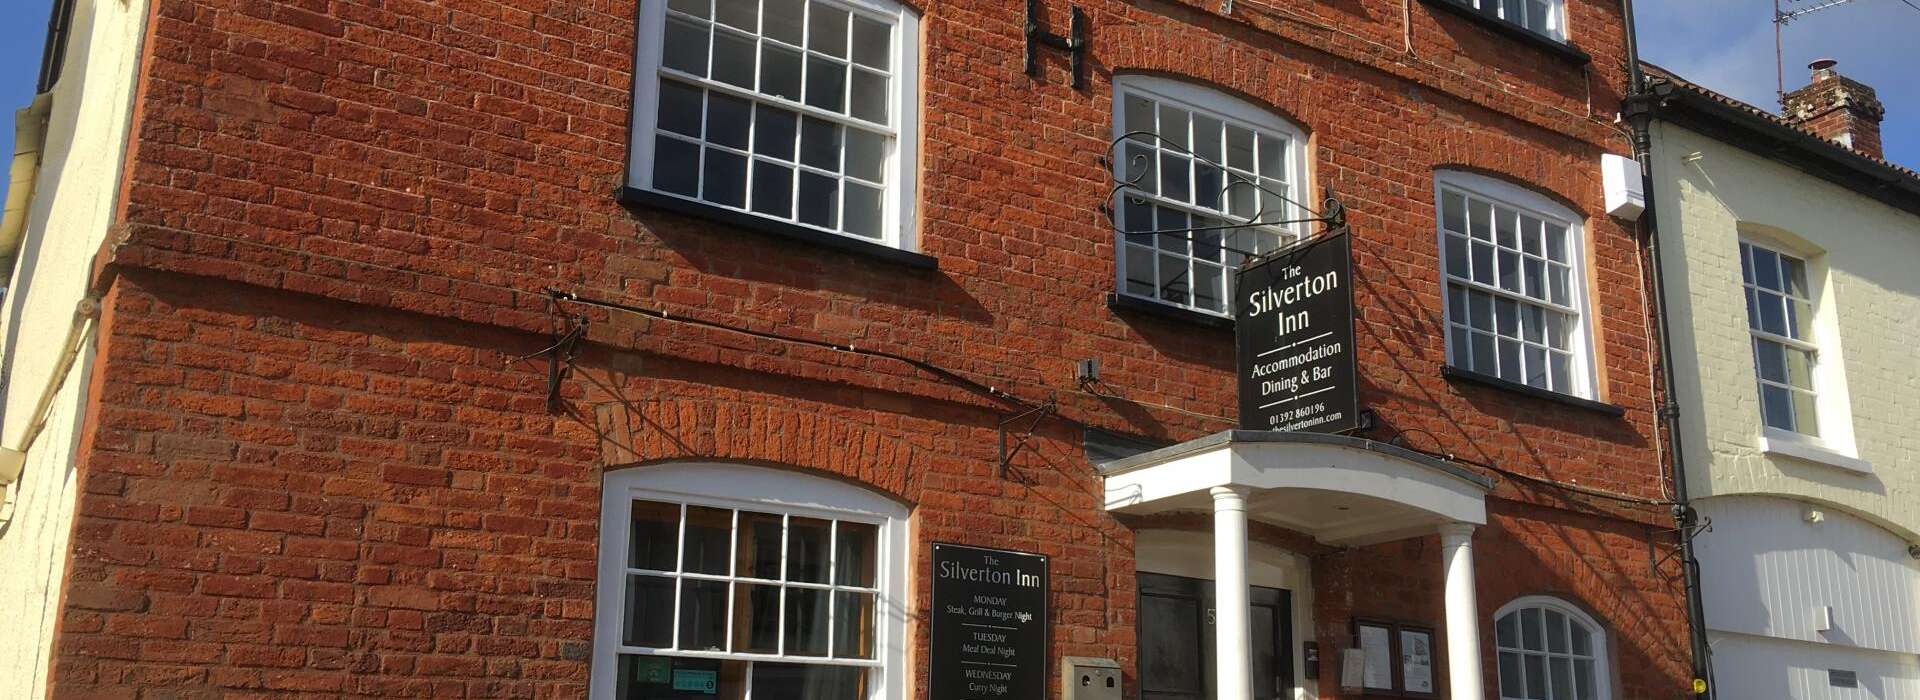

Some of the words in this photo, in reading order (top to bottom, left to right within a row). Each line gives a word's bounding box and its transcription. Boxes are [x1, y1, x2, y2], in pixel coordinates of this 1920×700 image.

[1281, 264, 1301, 281] The
[1249, 270, 1338, 317] Silverton
[1278, 310, 1309, 336] Inn
[1251, 341, 1341, 379] Accommodation
[1262, 373, 1298, 396] Dining
[1300, 369, 1310, 385] &
[1313, 365, 1332, 382] Bar
[1269, 410, 1294, 425] 01392
[1295, 402, 1325, 419] 860196
[984, 555, 1000, 566] The
[940, 560, 1011, 585] Silverton
[1016, 569, 1040, 588] Inn
[973, 595, 1007, 607] MONDAY
[969, 606, 983, 617] Grill
[984, 608, 990, 617] &
[992, 609, 1013, 621] Burger
[1014, 610, 1032, 623] Night
[973, 632, 1007, 643] TUESDAY
[962, 643, 979, 653] Meal
[980, 644, 996, 655] Deal
[997, 645, 1016, 658] Night
[965, 669, 1012, 681] WEDNESDAY
[969, 682, 988, 694] Curry
[989, 683, 1008, 695] Night
